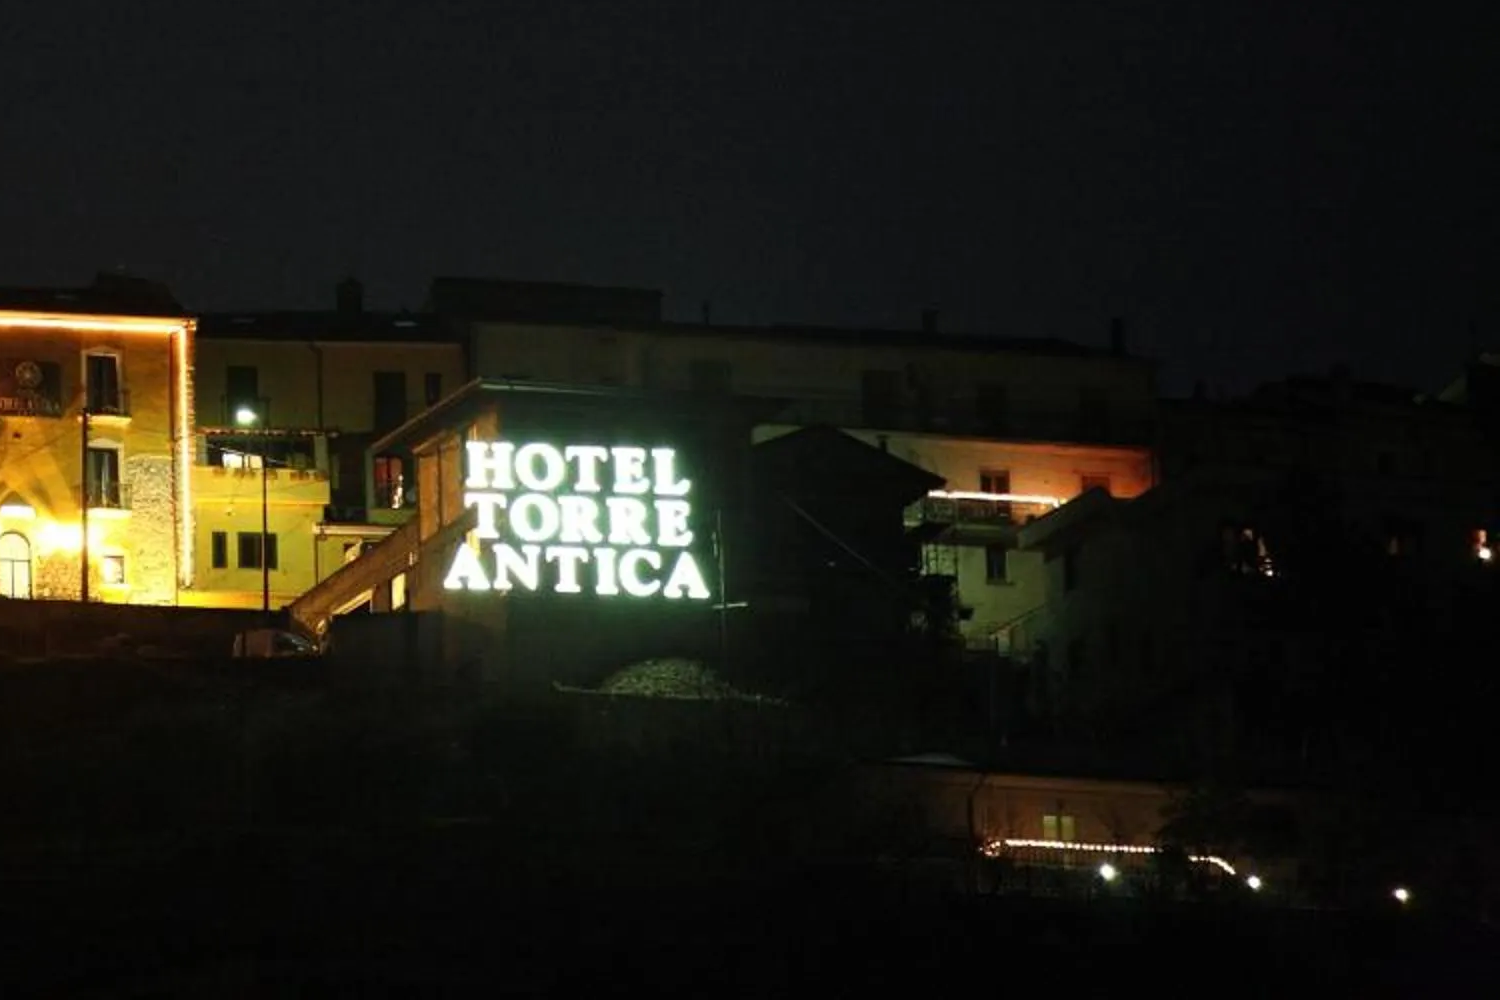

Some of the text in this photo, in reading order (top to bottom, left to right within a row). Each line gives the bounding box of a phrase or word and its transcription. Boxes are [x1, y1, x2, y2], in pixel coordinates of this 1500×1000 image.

[465, 440, 692, 495] HOTEL
[463, 493, 694, 547] TORRE
[443, 542, 711, 599] ANTICA
